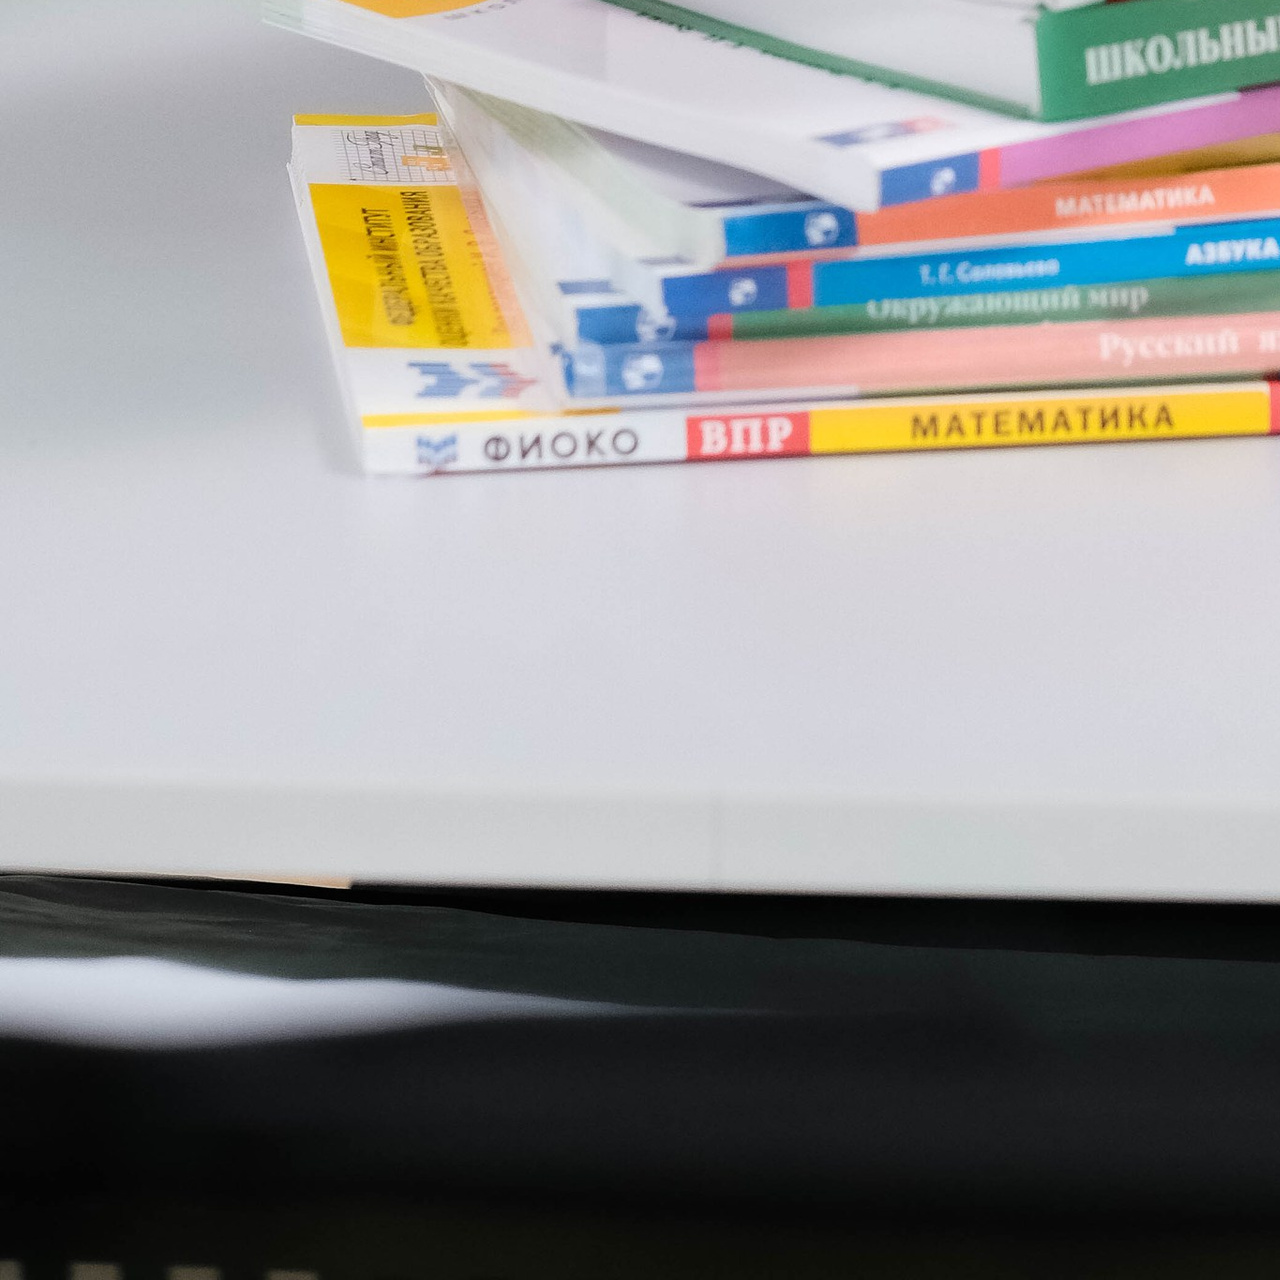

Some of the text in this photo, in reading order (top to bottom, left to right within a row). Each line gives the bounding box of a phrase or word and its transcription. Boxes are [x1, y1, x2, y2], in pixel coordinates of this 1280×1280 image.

[1055, 185, 1215, 216] МАТЕМАТИКА
[1184, 236, 1280, 266] АЗБУКА
[1088, 285, 1149, 314] мир
[1100, 328, 1239, 366] Русский
[484, 427, 640, 464] ФИОКО
[698, 414, 793, 456] ВПР
[910, 402, 1175, 440] МАТЕМАТИКА
